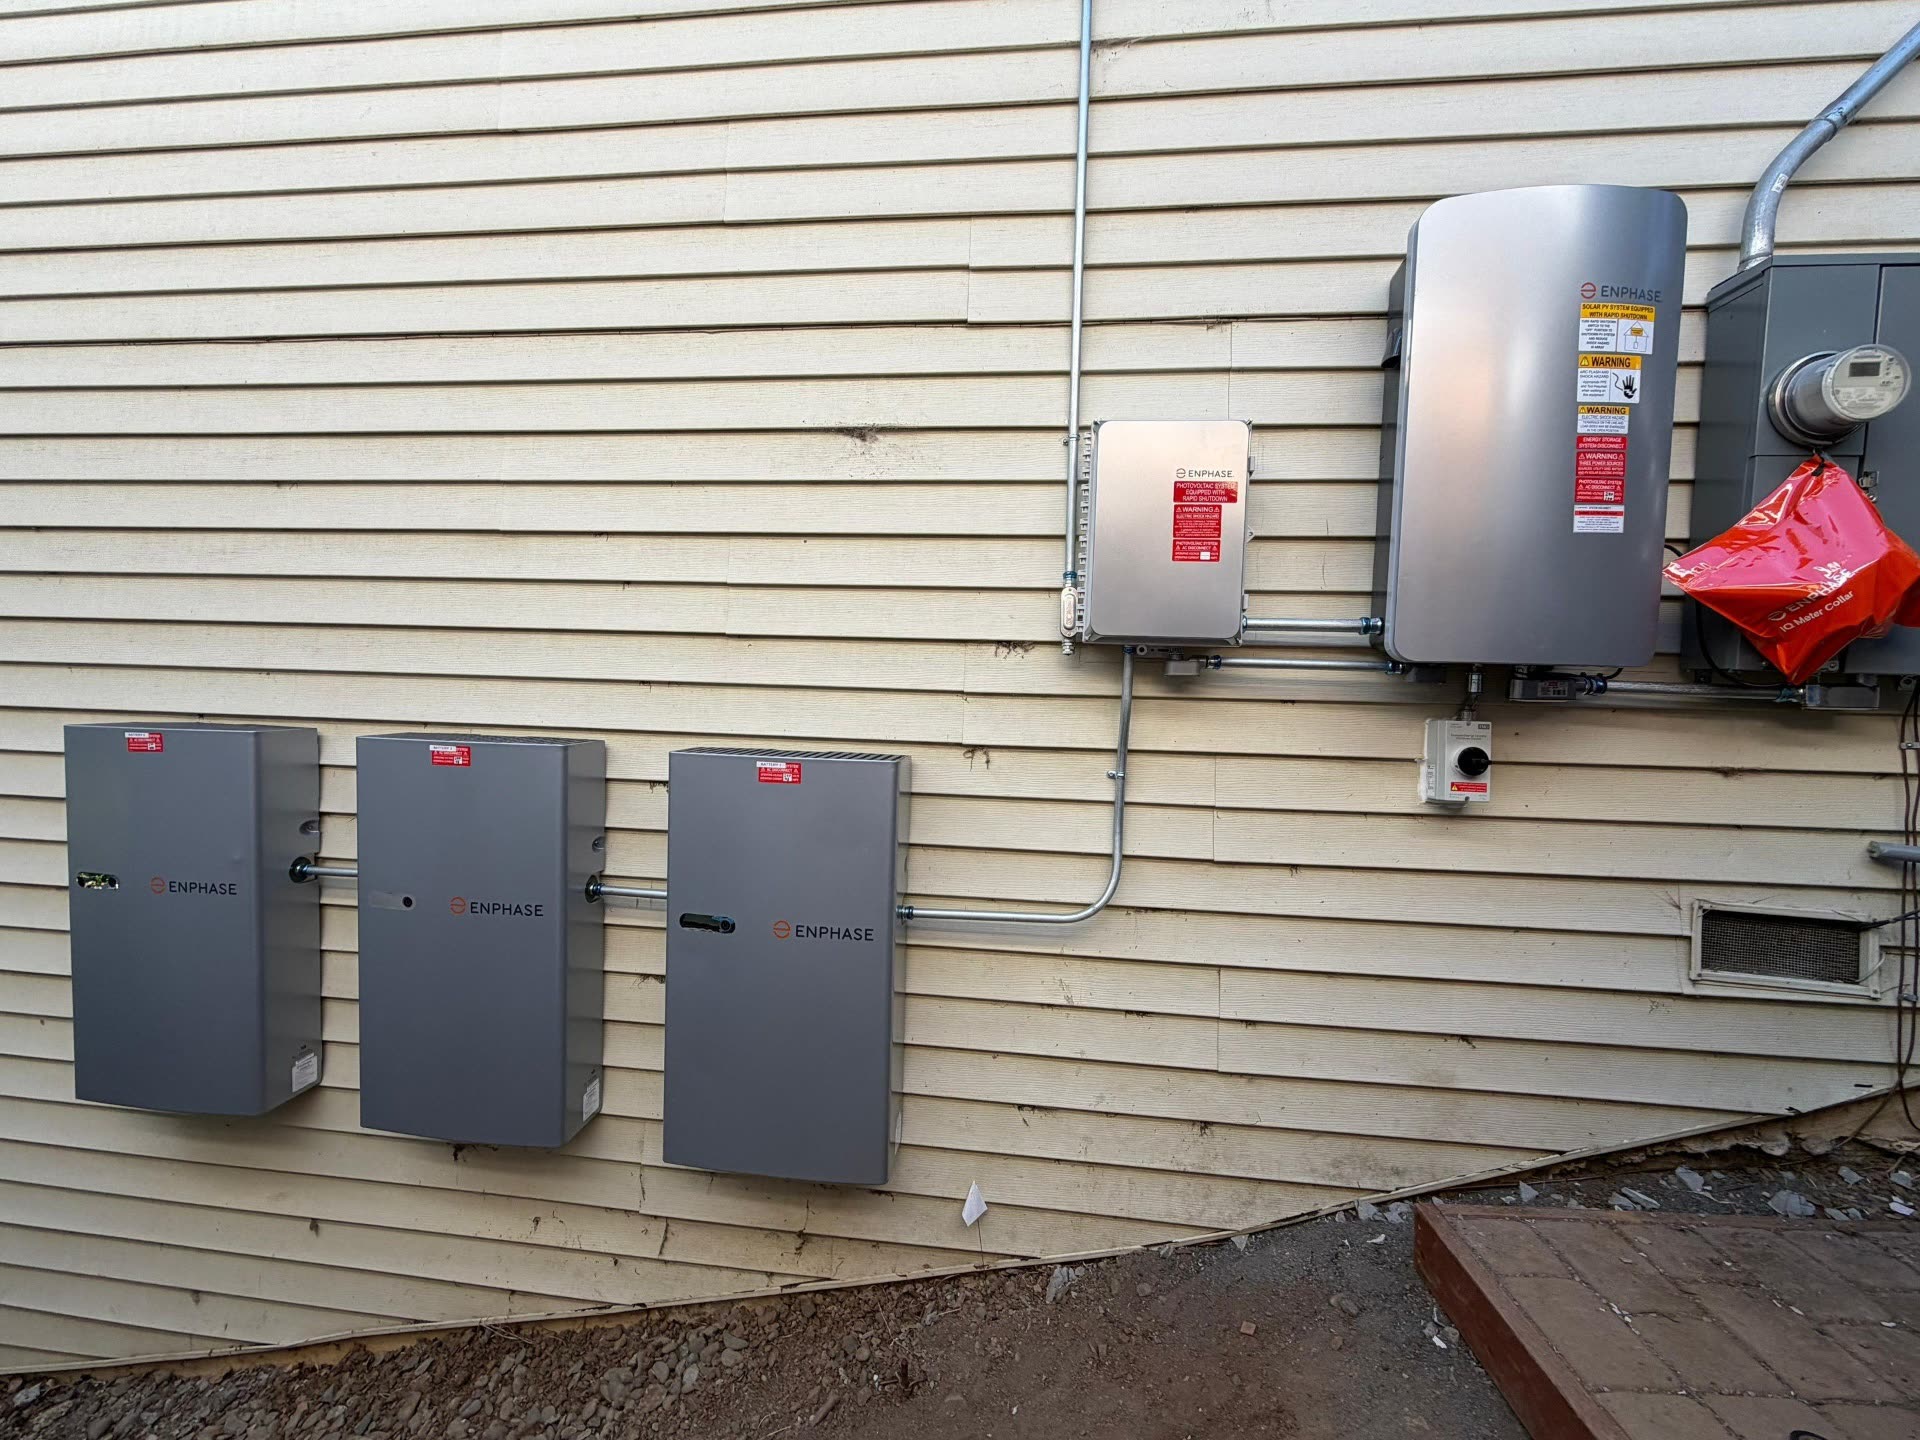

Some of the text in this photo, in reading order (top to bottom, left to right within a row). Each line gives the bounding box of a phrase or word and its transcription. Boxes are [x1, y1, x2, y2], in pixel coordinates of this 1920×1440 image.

[1601, 285, 1662, 303] ENPHASE
[1592, 356, 1630, 368] WARNING
[1188, 470, 1232, 478] ENPHASE
[1786, 569, 1855, 612] ENPHASE
[1779, 590, 1854, 632] IQ Meter Collar
[169, 881, 237, 895] ENPHASE
[470, 902, 543, 916] ENPHASE
[796, 925, 874, 941] ENPHASE
